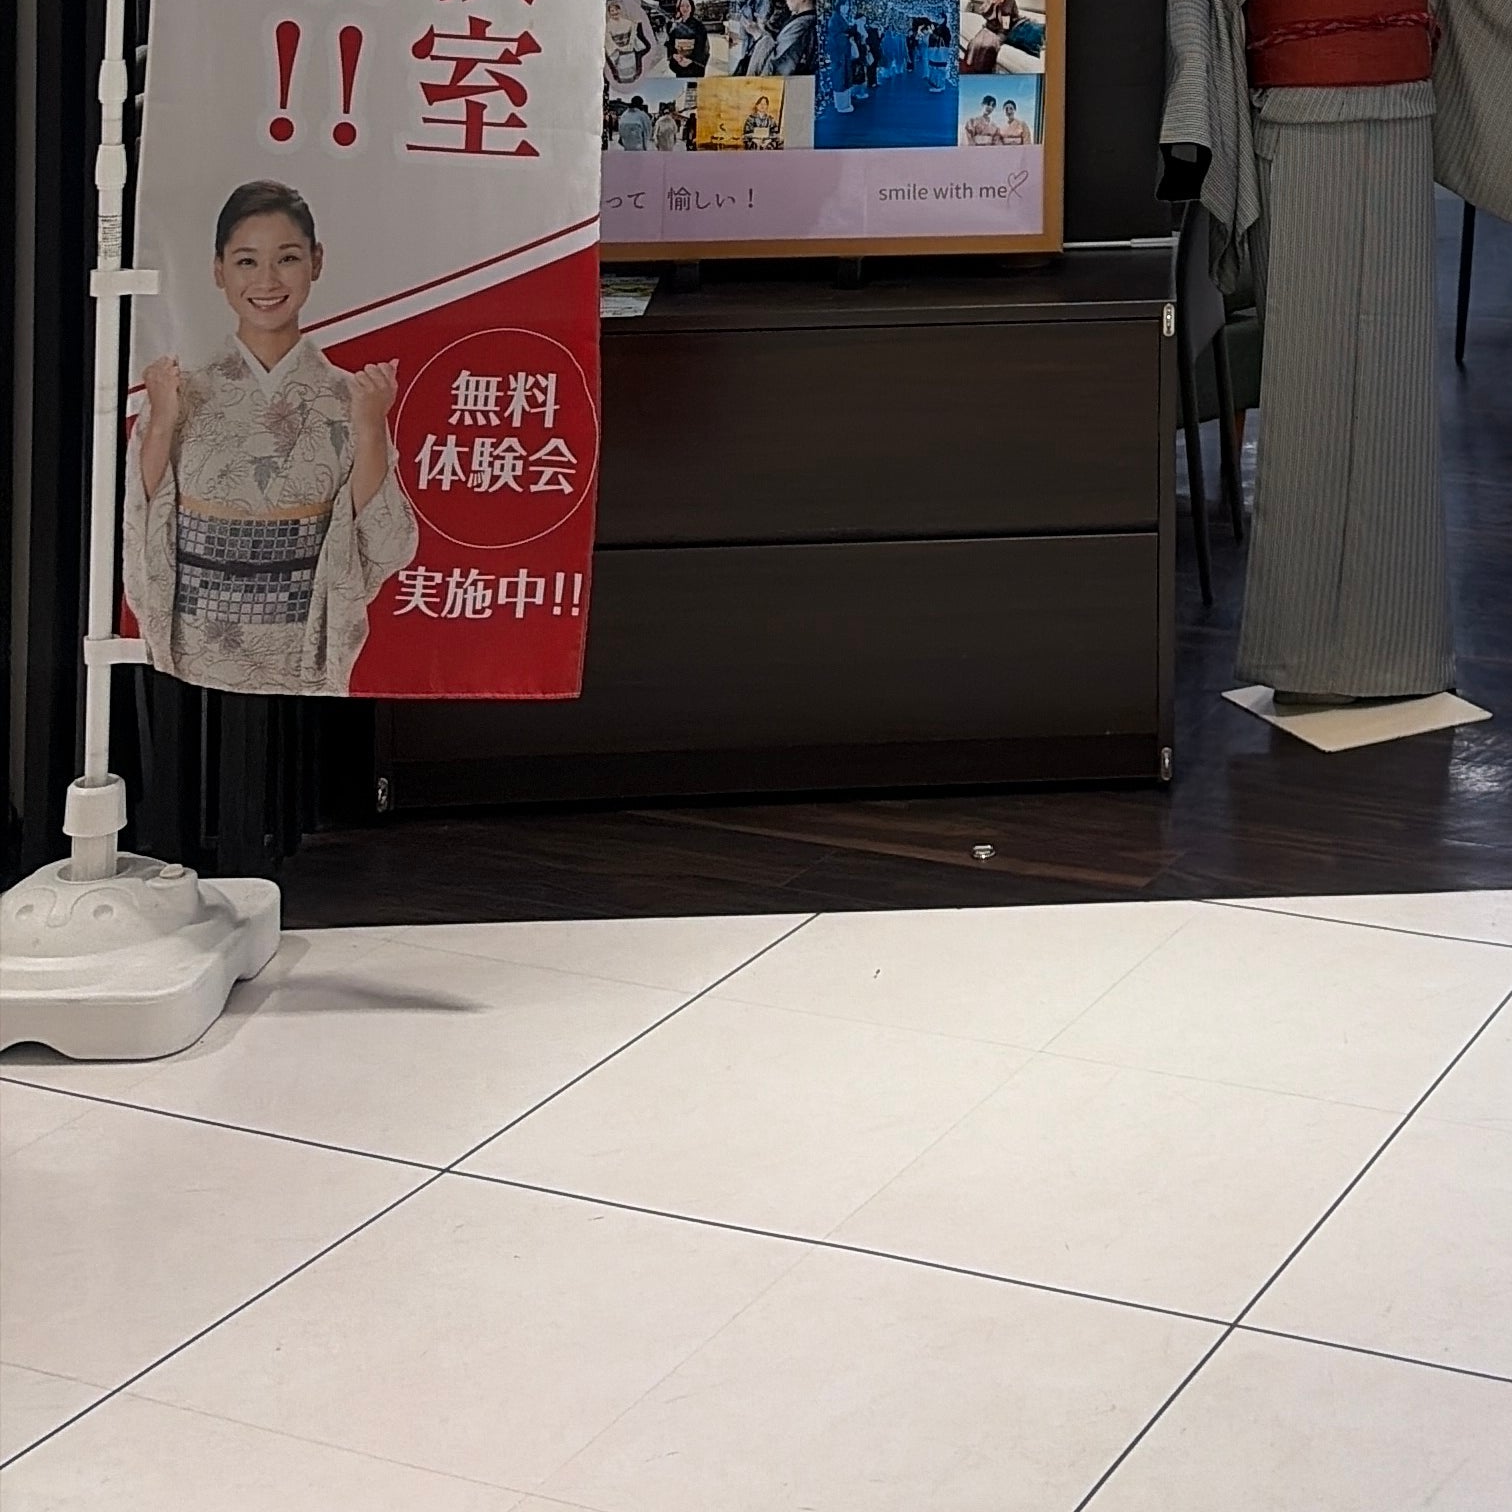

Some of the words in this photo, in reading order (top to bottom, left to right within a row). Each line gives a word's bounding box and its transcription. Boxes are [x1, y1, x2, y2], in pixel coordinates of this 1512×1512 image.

[878, 183, 928, 202] smile
[934, 181, 973, 200] with
[979, 185, 1008, 199] me
[447, 370, 560, 429] 無料
[413, 434, 578, 495] 体験会
[393, 566, 581, 620] 実施中!!
